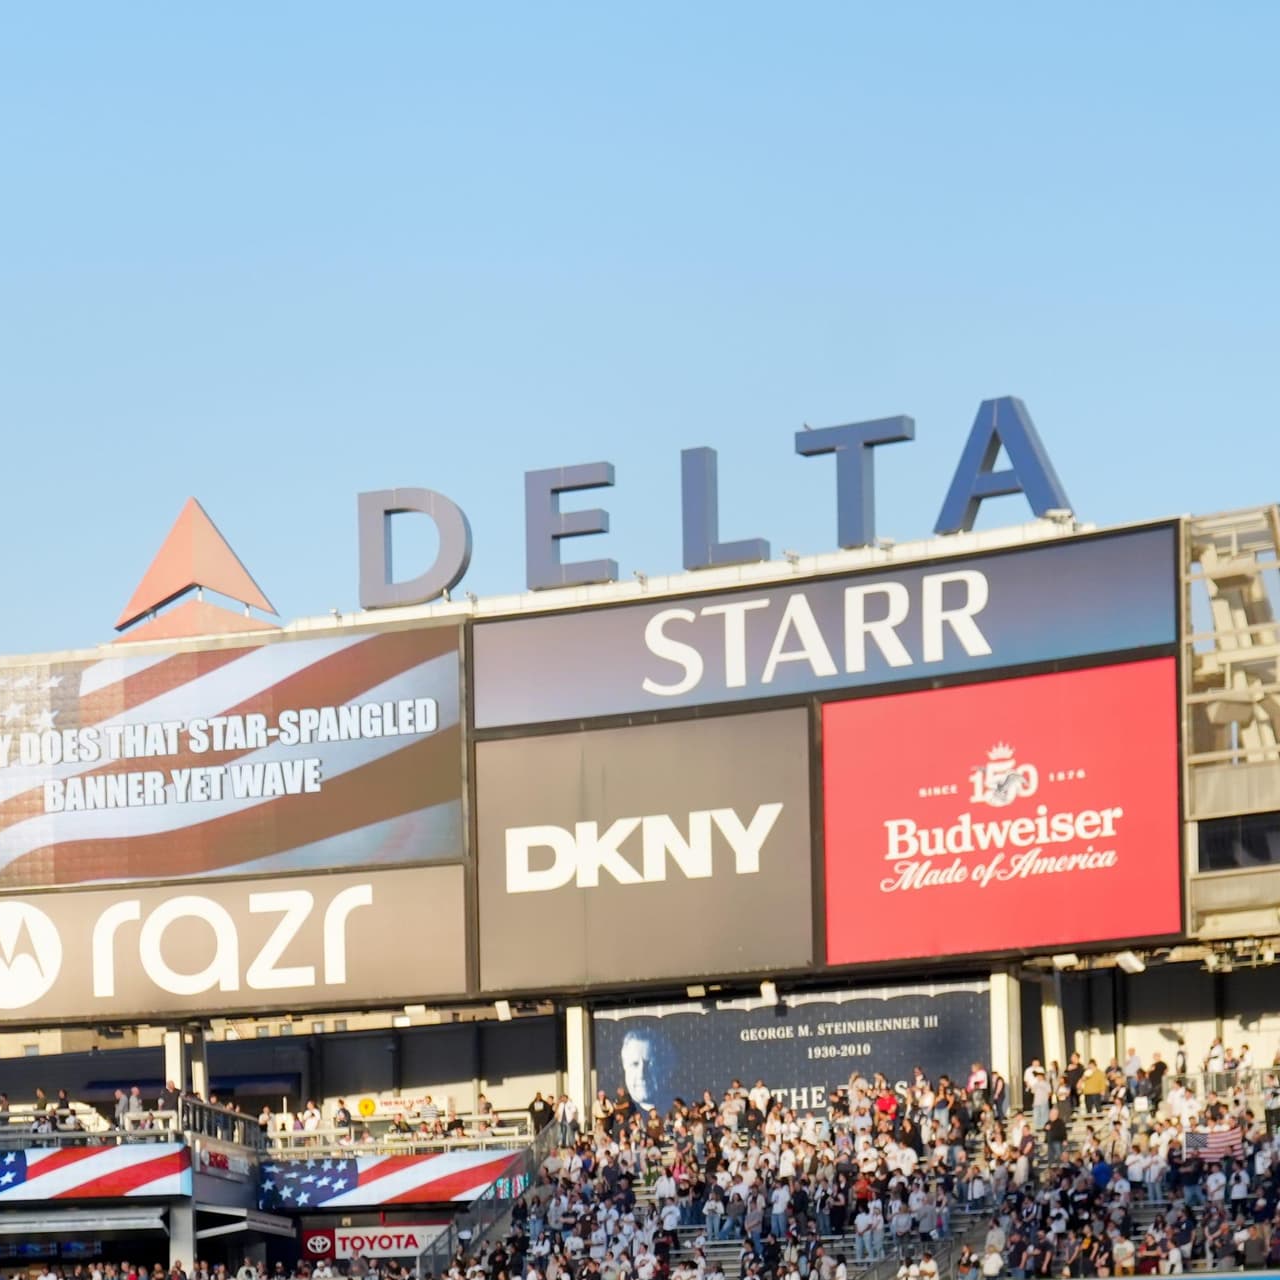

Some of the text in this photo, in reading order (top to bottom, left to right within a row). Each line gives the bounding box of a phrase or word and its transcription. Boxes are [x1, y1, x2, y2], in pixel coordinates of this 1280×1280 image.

[357, 396, 1075, 609] DELTA
[641, 569, 993, 696] STARR
[20, 728, 100, 765] DOES
[105, 721, 185, 760] THAT
[188, 697, 438, 754] STAR-SPANGLED
[44, 758, 322, 813] BANNER YET WAVE
[919, 784, 958, 798] SINCE
[505, 802, 784, 894] DKNY
[884, 805, 1123, 860] Budweiser
[880, 845, 1118, 892] Made of America
[92, 884, 373, 998] razr
[740, 1015, 939, 1042] GEORGE M. STEINBRENNER III
[807, 1043, 871, 1059] 1930-2010
[771, 1086, 827, 1111] THE
[338, 1234, 419, 1250] TOYOTA
